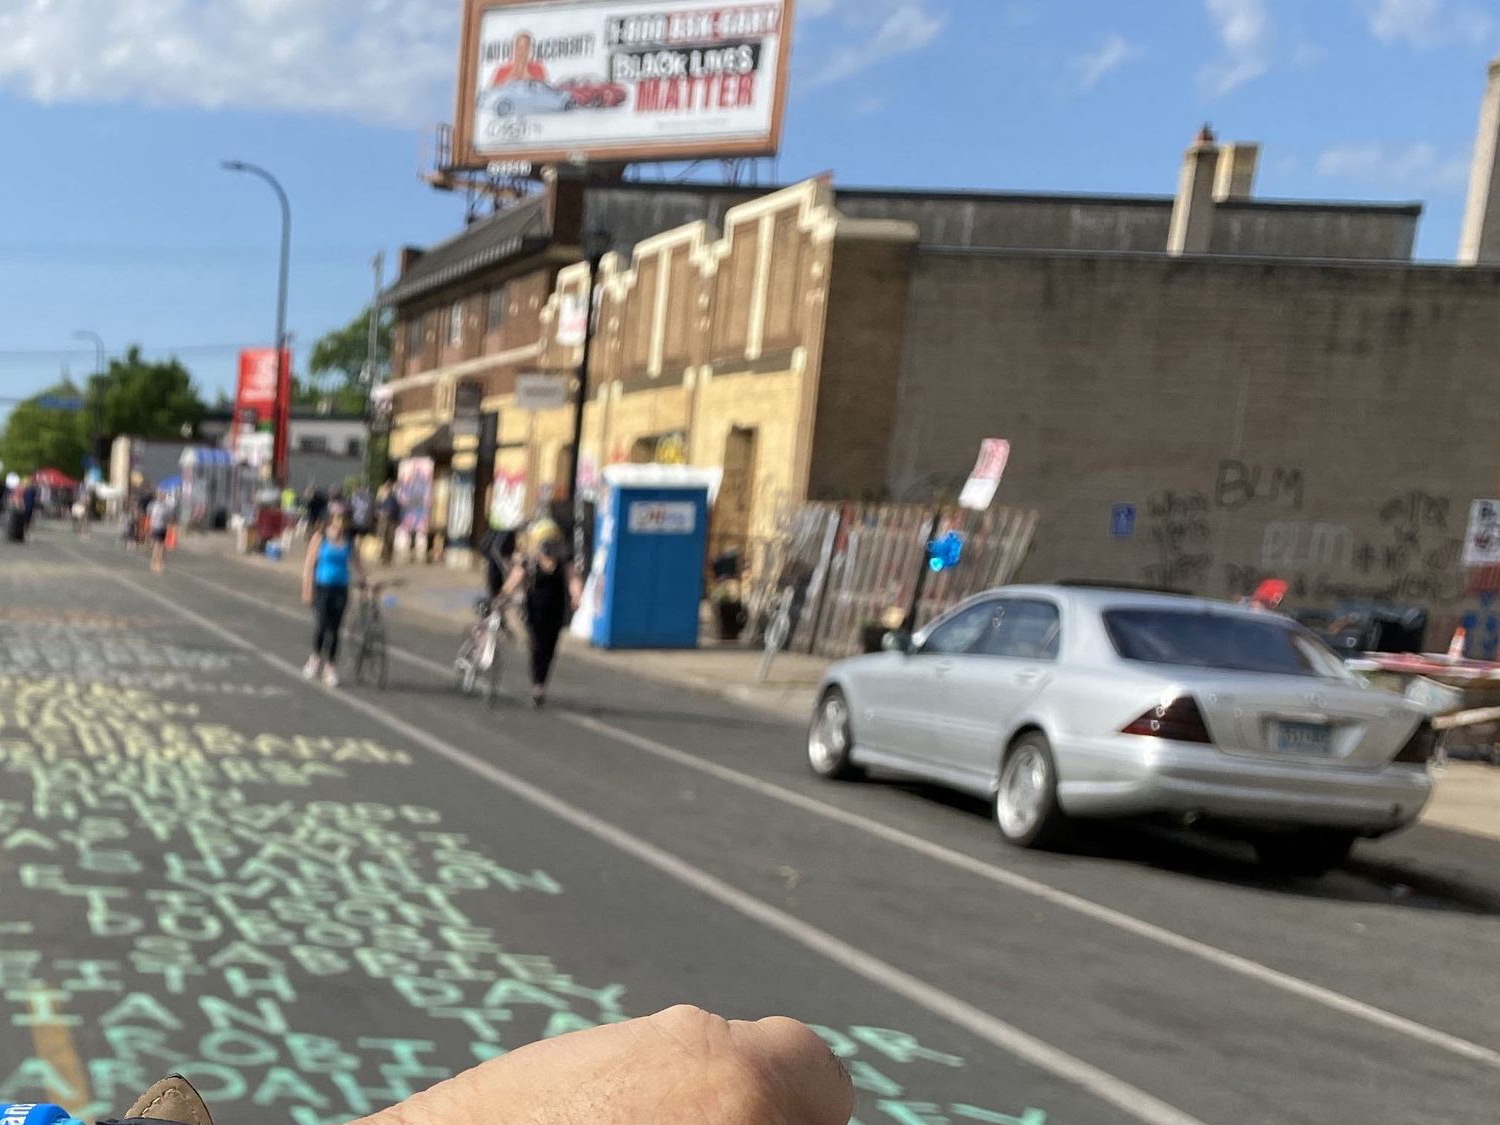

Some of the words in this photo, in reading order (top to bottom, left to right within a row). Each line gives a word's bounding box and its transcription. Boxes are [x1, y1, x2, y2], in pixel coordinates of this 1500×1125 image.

[613, 49, 687, 79] BLACK
[634, 72, 754, 112] MATTER
[390, 970, 628, 1024] DAY
